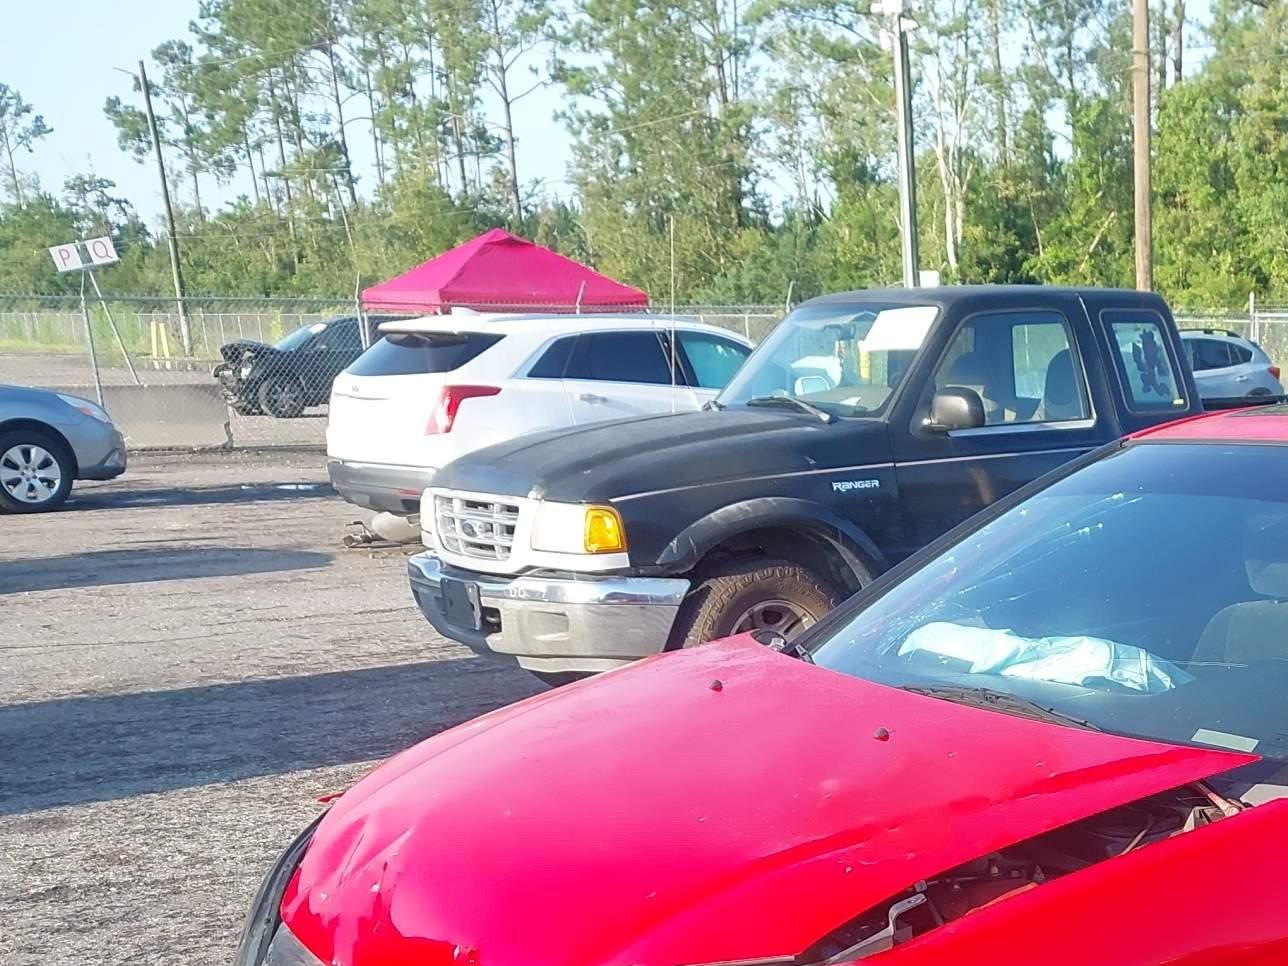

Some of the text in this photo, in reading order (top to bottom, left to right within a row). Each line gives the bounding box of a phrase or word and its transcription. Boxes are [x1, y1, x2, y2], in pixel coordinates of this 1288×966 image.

[58, 248, 70, 266] P
[92, 240, 113, 259] Q
[831, 479, 880, 492] RANGER
